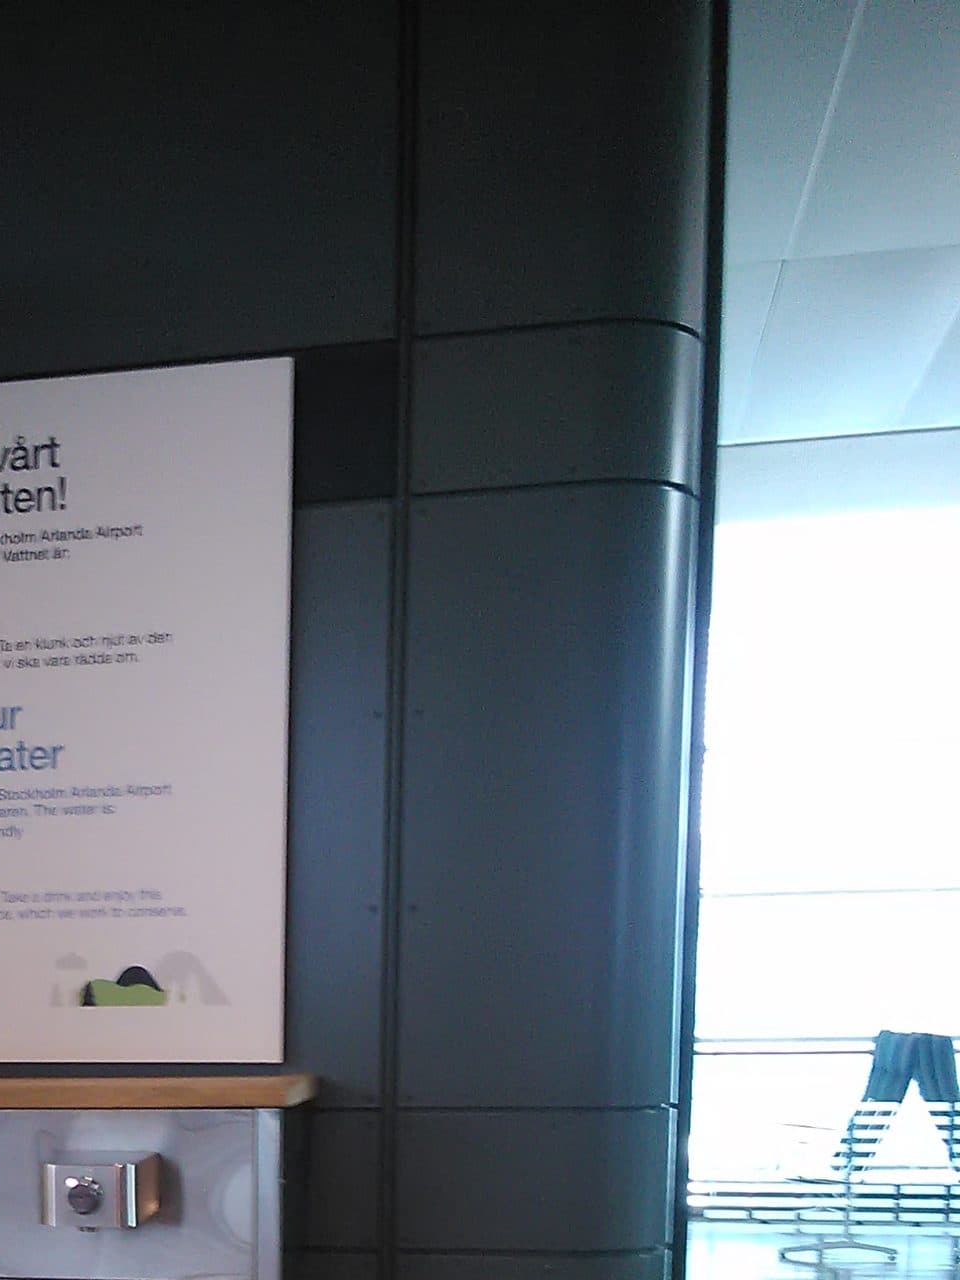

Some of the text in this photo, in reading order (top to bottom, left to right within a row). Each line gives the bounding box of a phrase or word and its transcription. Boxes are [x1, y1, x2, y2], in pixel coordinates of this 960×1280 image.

[40, 527, 92, 542] Arlanda
[95, 524, 144, 540] Airport
[3, 548, 50, 563] Vattnet
[34, 804, 58, 816] The
